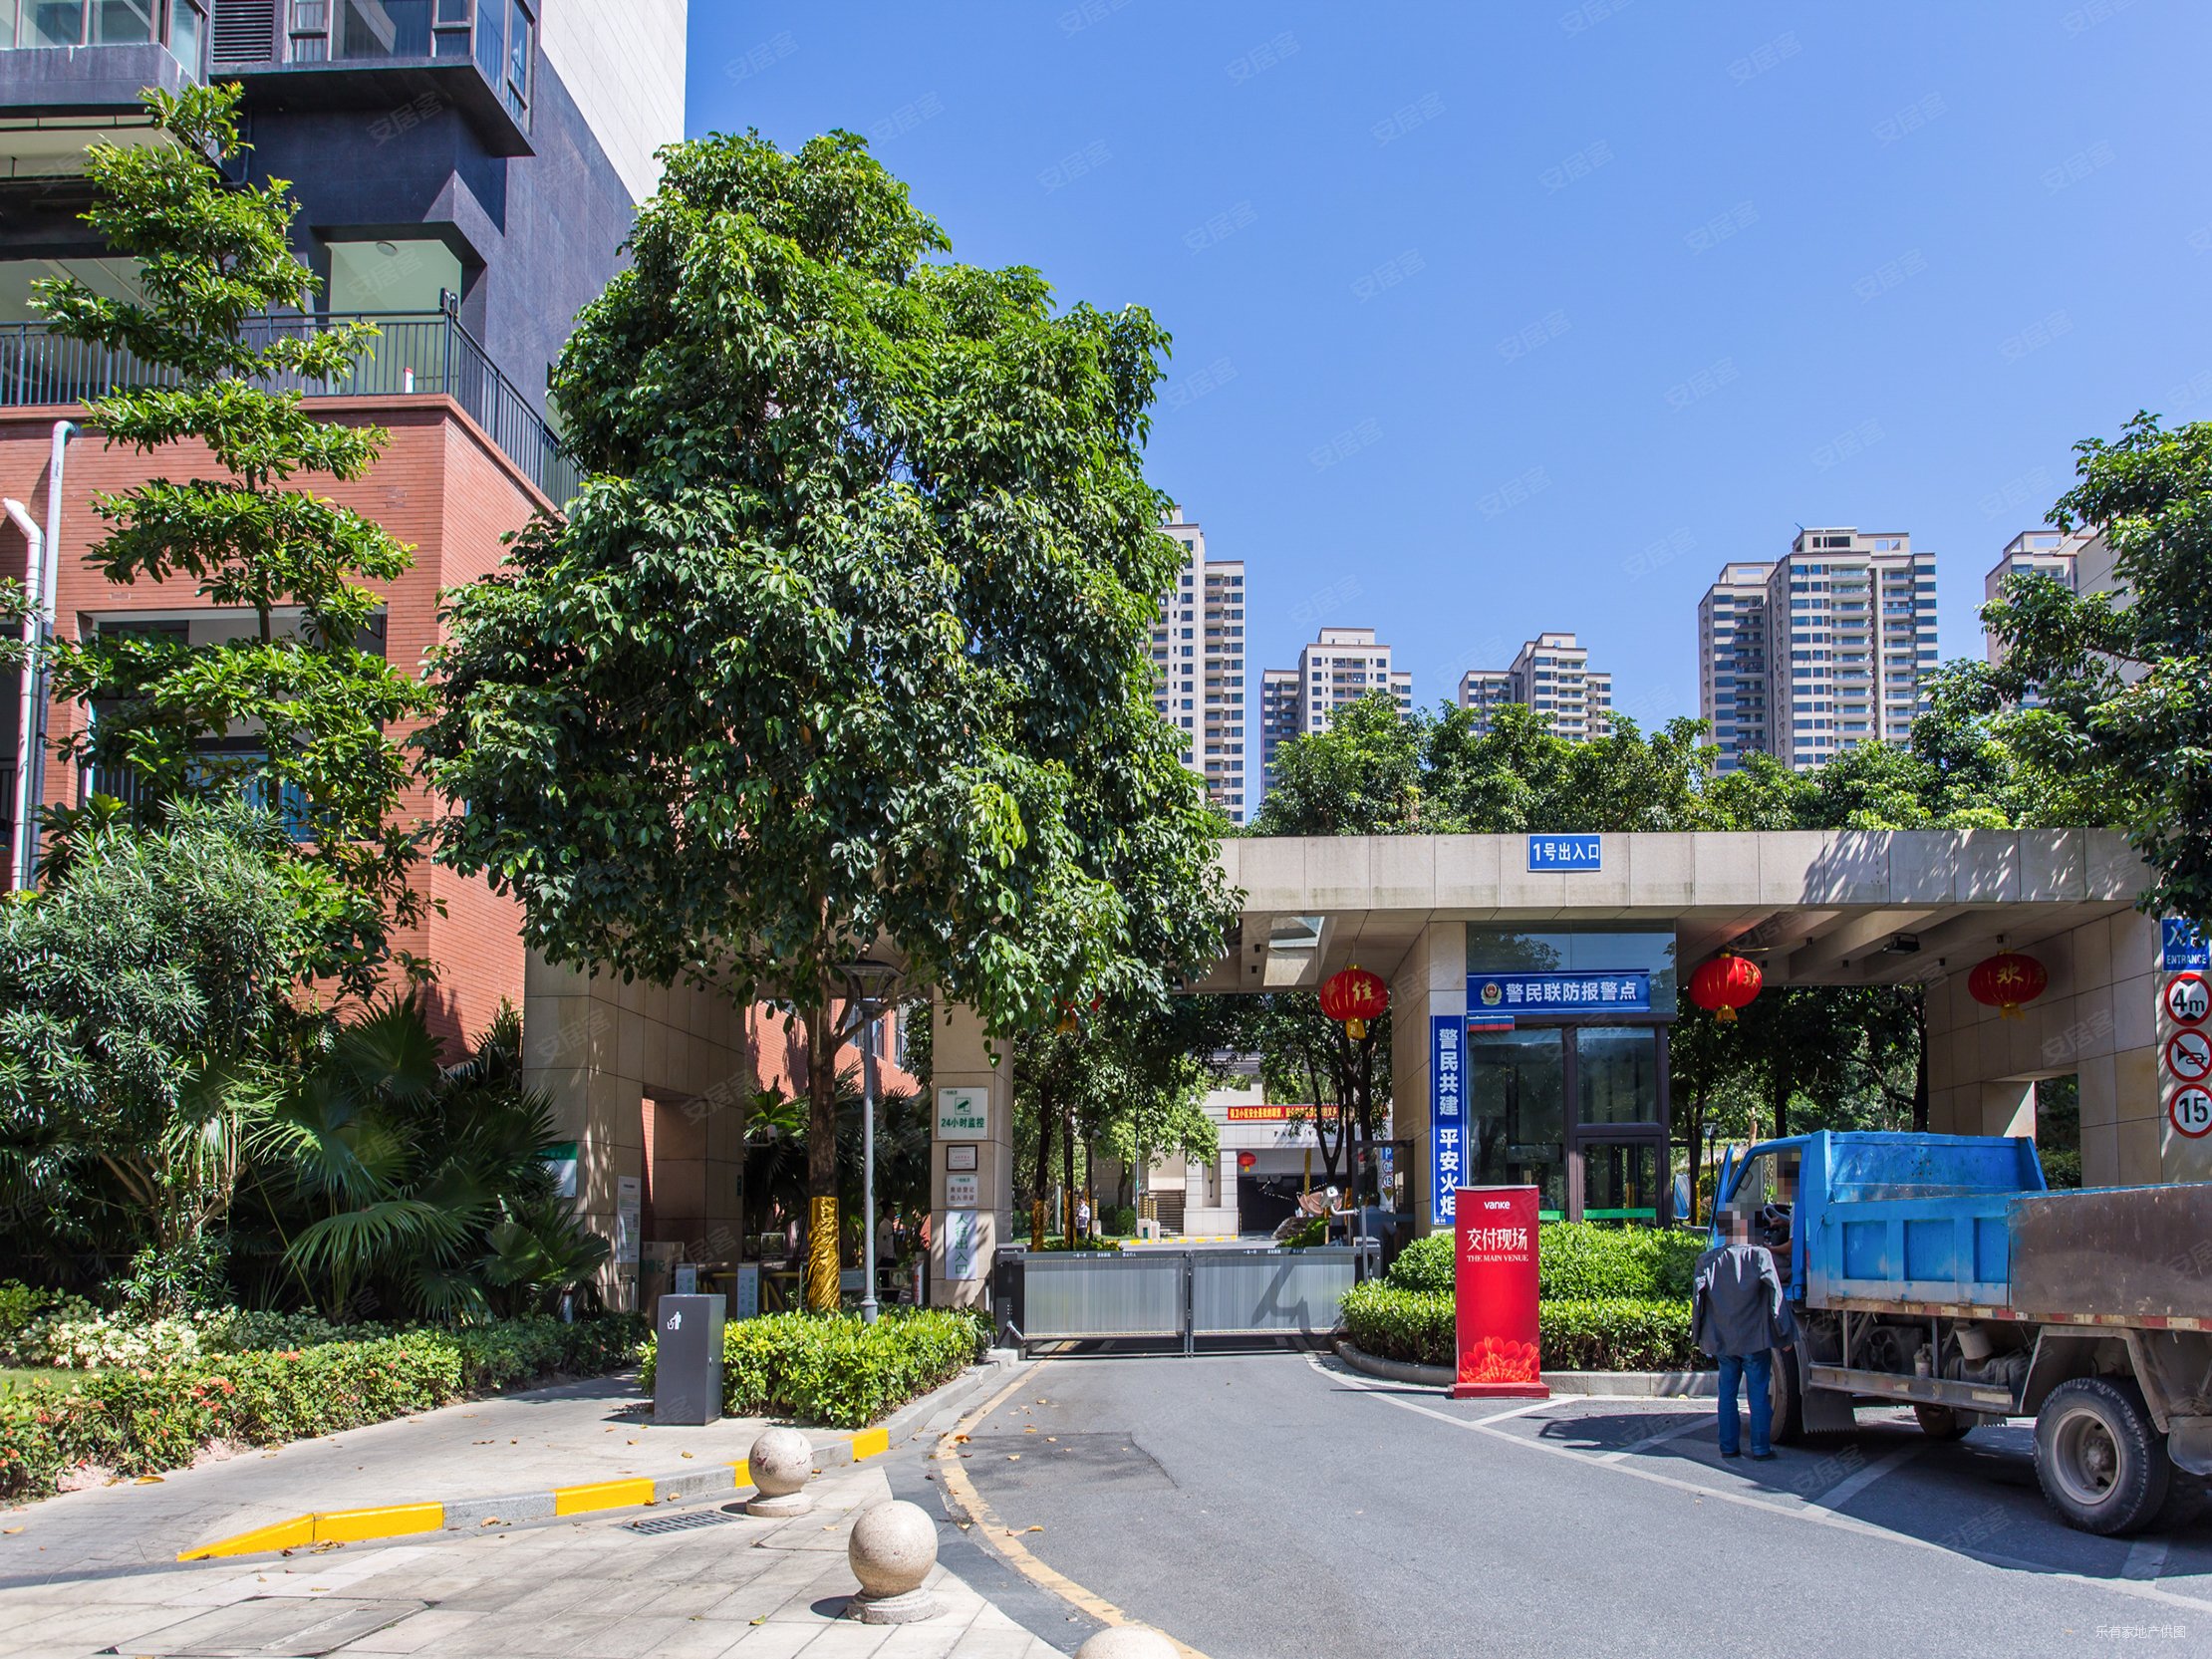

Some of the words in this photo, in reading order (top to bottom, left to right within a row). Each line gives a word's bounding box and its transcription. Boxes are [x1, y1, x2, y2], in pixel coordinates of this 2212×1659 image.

[1532, 842, 1599, 861] 1号出入口
[2166, 954, 2207, 966] ENTRANCE
[1506, 980, 1637, 1003] 警民联防报警点
[2172, 987, 2205, 1012] 4m
[1439, 1028, 1459, 1116] 警民共建
[2178, 1097, 2208, 1124] 15
[941, 1117, 985, 1129] 24小时监控
[1439, 1128, 1459, 1216] 平安火炬
[1484, 1201, 1511, 1210] vanke
[955, 1214, 968, 1274] 人行出入口
[1467, 1228, 1527, 1251] 交付现场
[1503, 1253, 1529, 1262] VENUE
